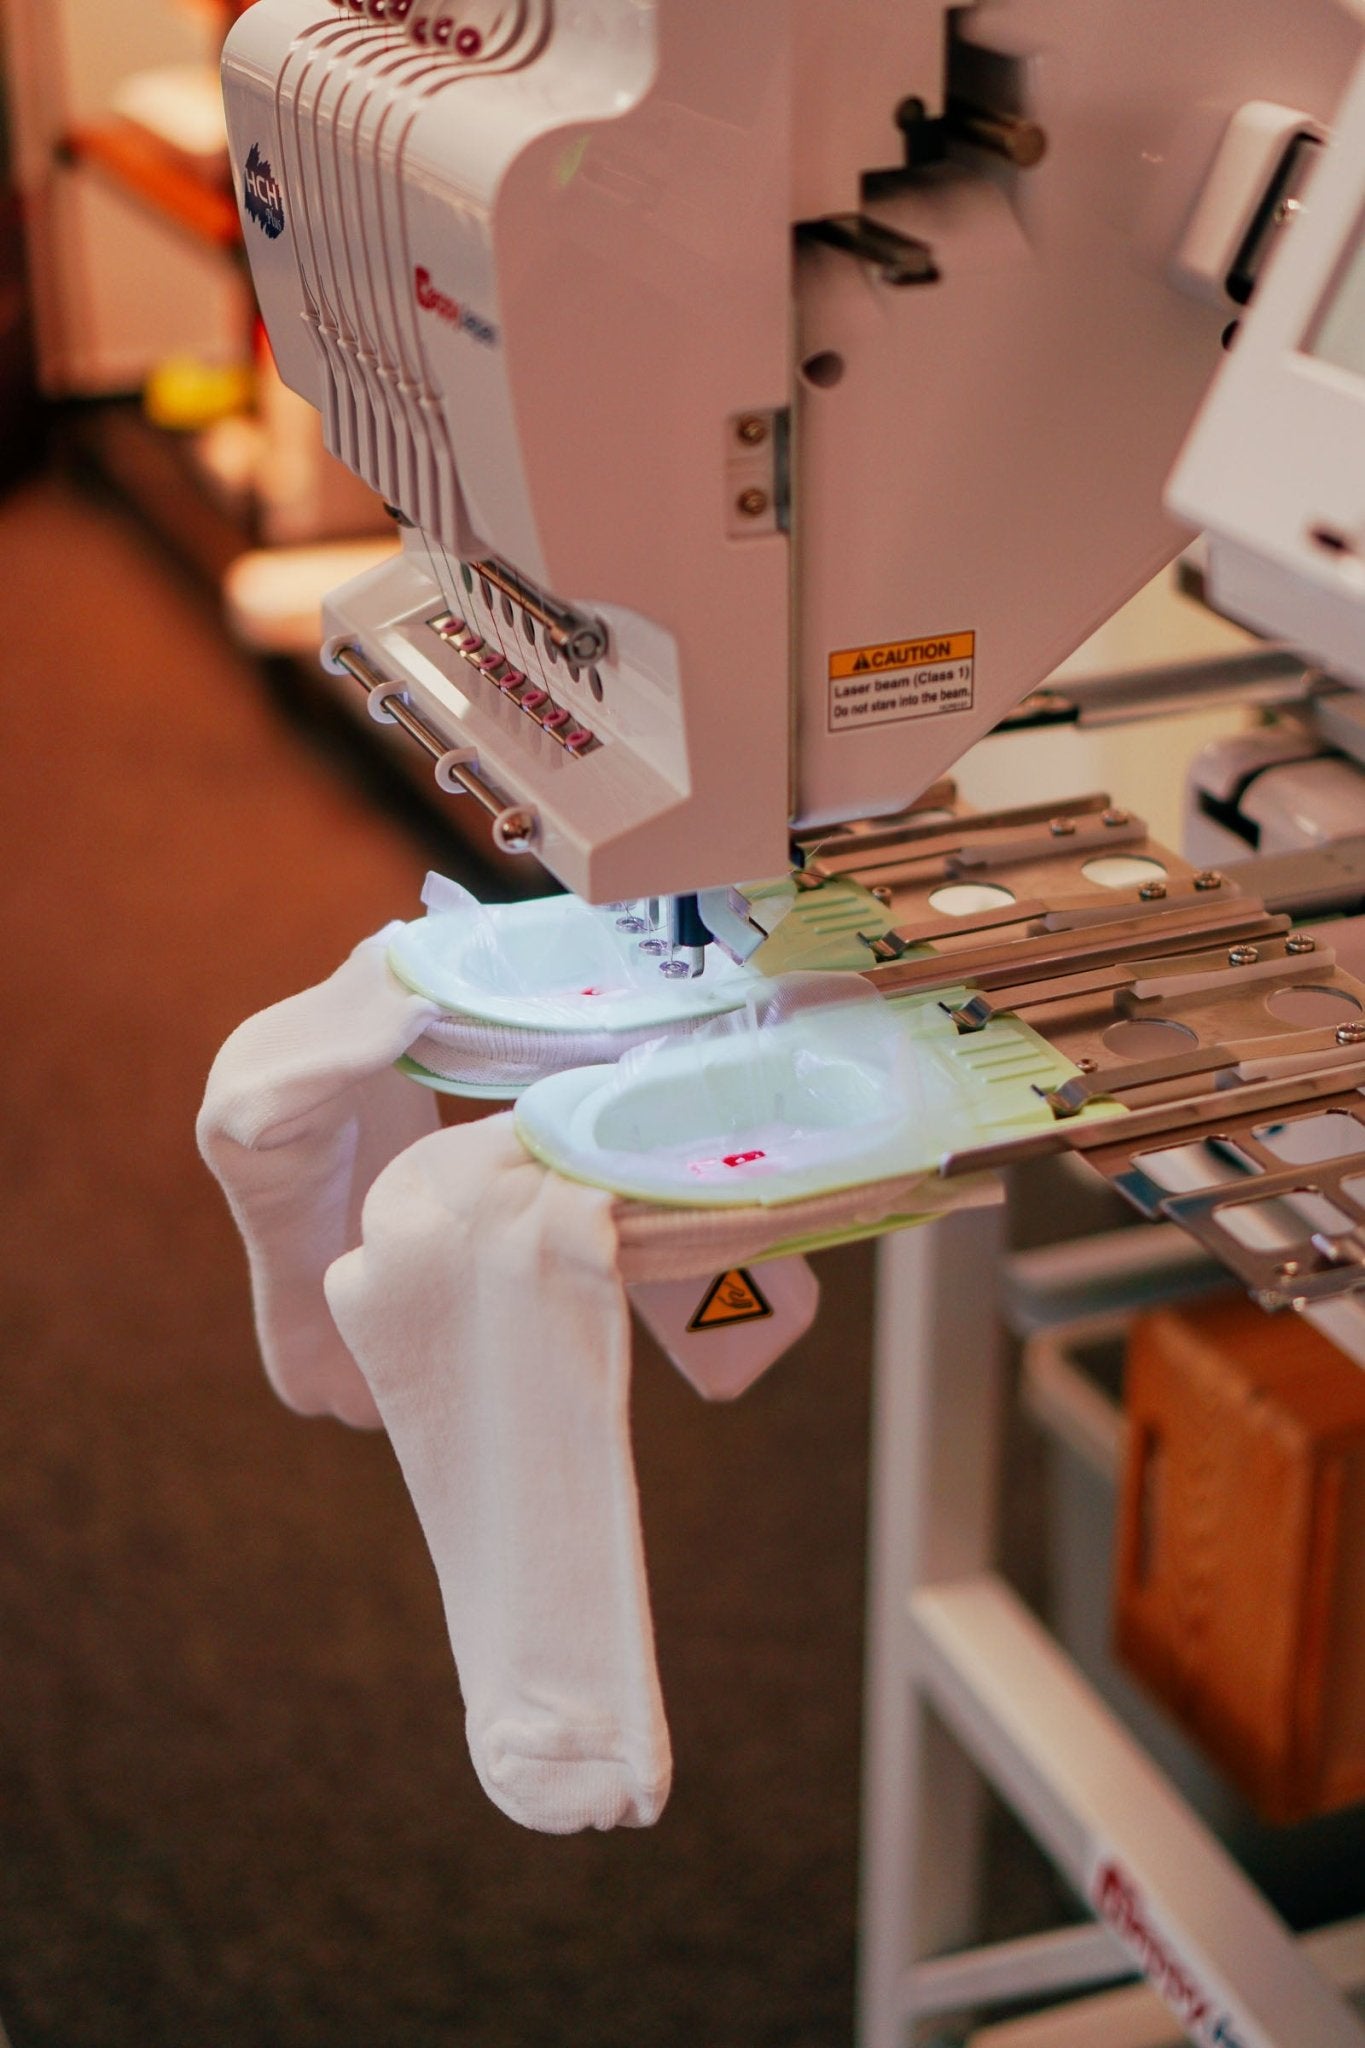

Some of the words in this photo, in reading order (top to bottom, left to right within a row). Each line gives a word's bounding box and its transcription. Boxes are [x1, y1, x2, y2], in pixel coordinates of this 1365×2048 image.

[244, 168, 279, 211] HCH
[871, 641, 951, 667] CAUTION
[834, 683, 870, 699] Laser
[874, 677, 910, 691] beam
[913, 669, 954, 688] (Class
[958, 665, 970, 680] 1)
[834, 704, 849, 718] Do
[851, 702, 868, 715] not
[871, 698, 896, 713] stare
[899, 694, 919, 708] into
[921, 691, 937, 704] the
[940, 687, 970, 701] beam.
